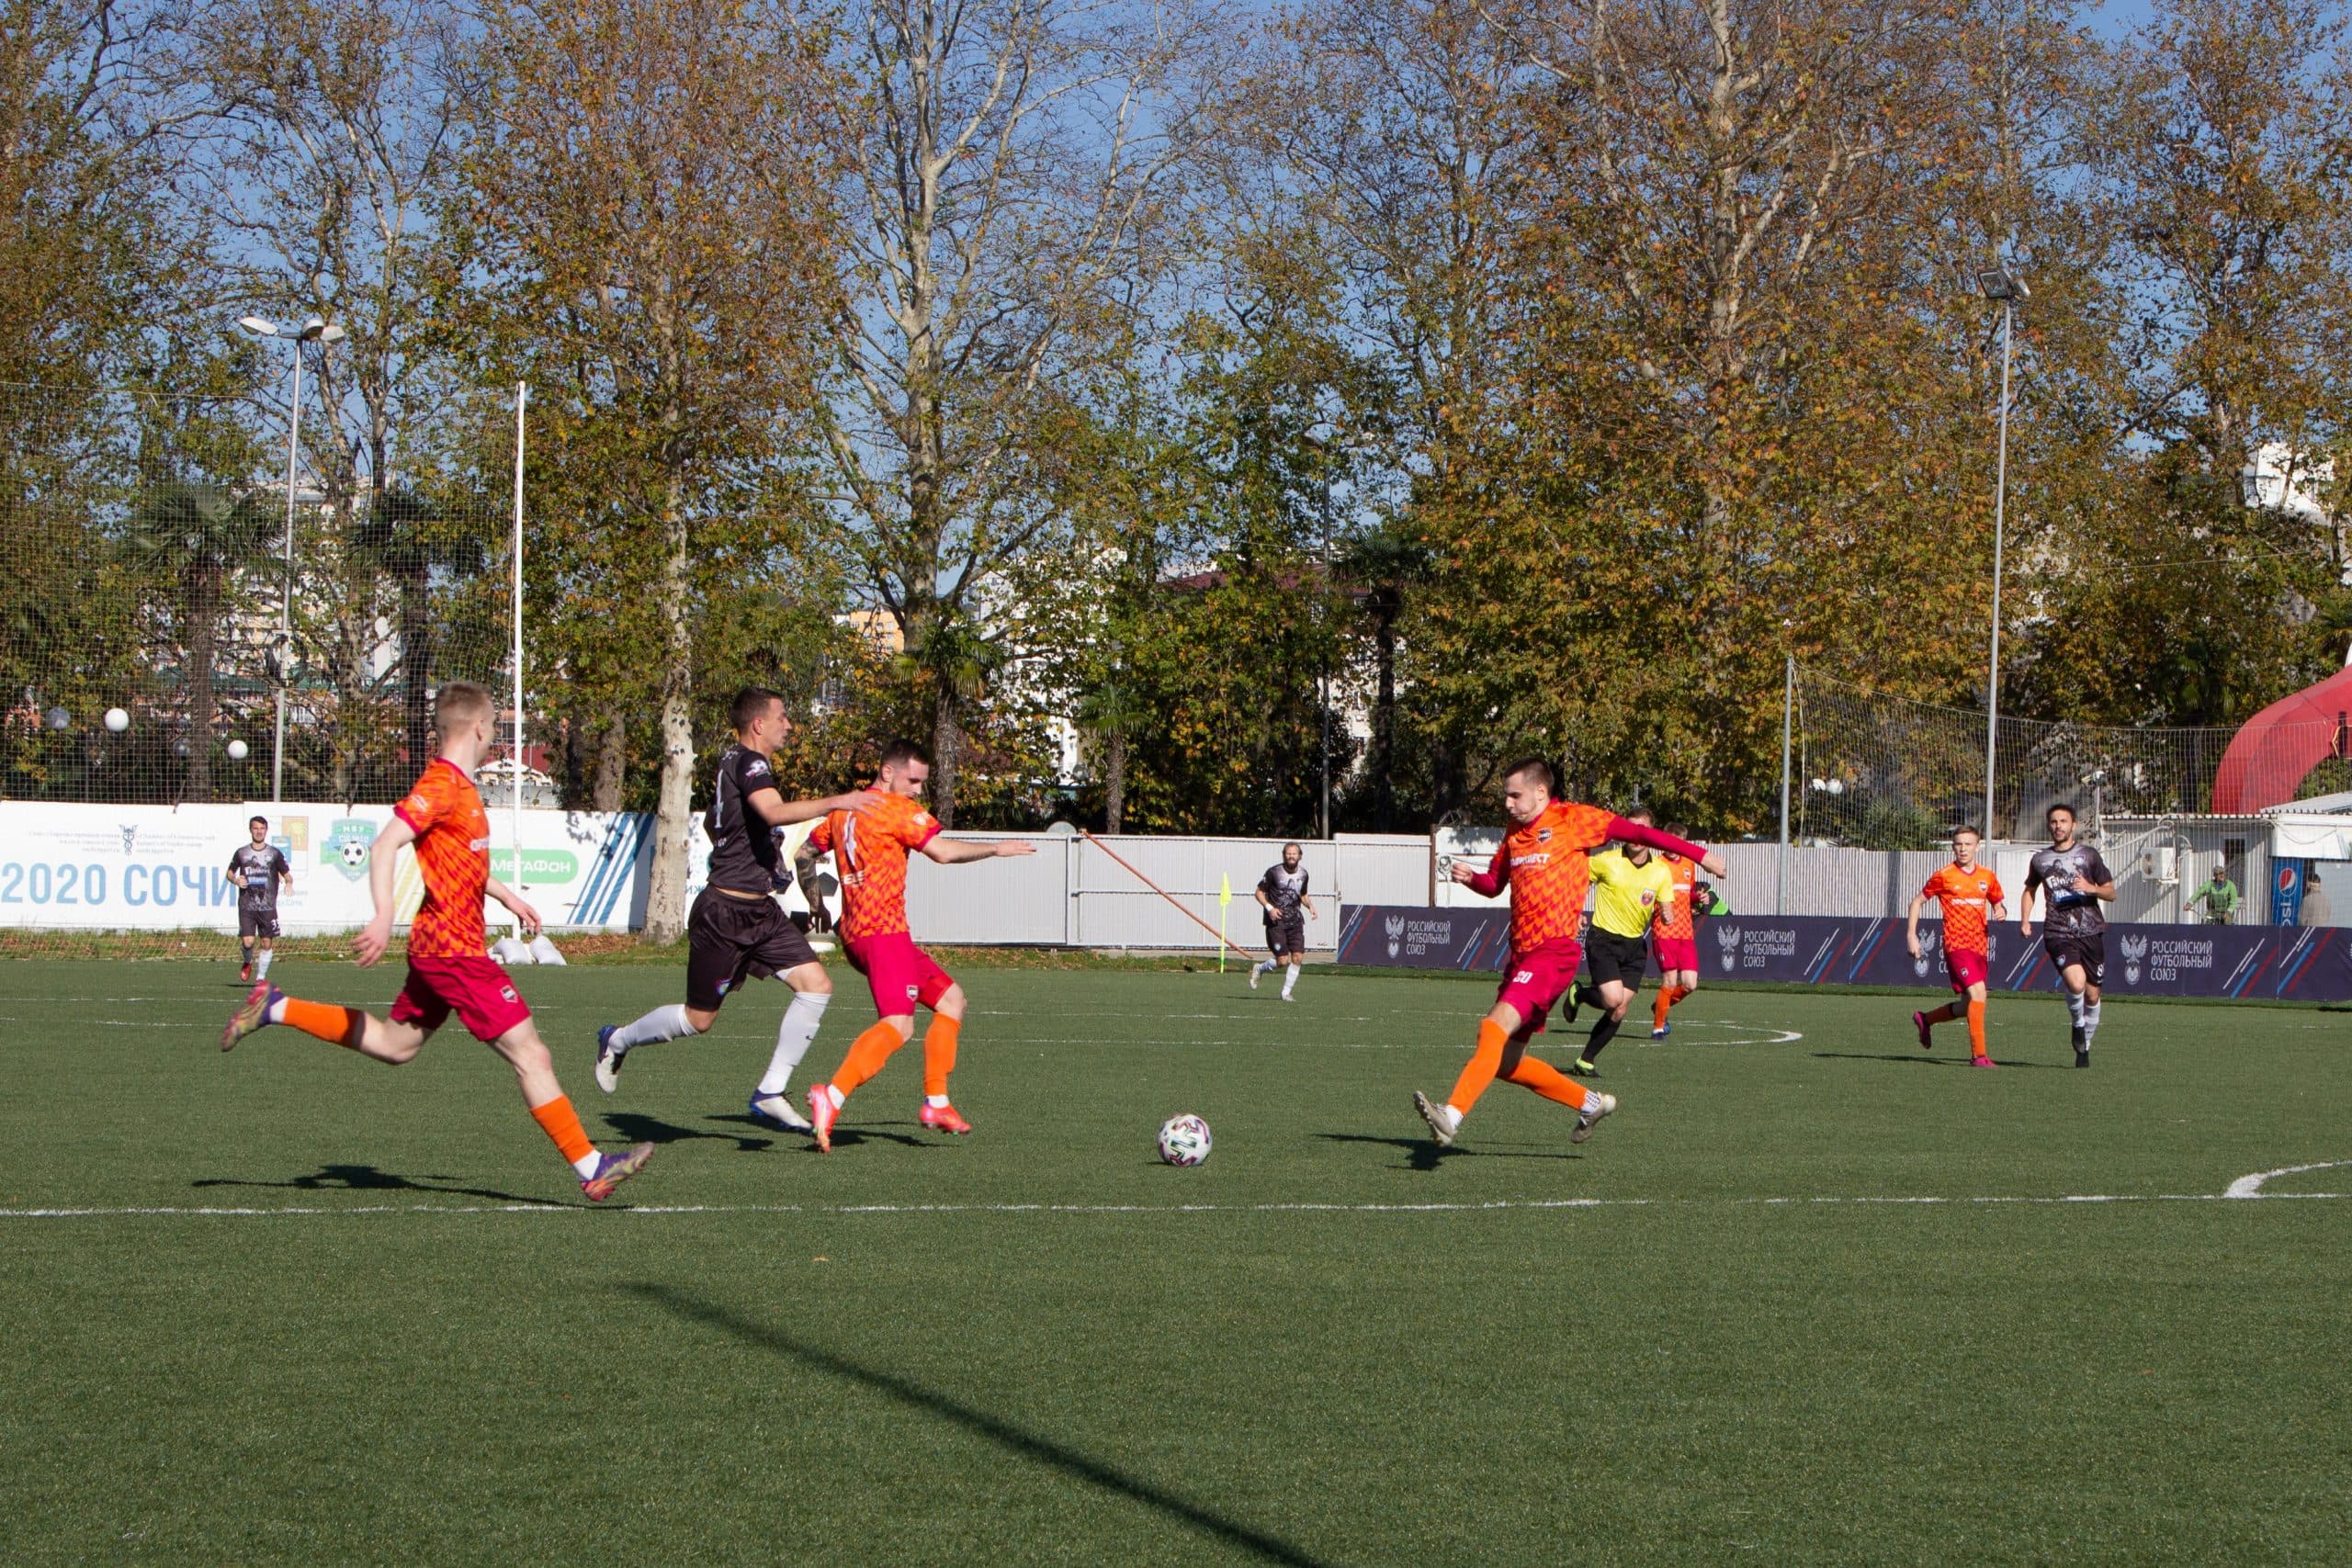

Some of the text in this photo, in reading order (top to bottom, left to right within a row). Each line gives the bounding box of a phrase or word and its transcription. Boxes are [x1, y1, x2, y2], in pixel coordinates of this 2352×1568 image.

[1, 863, 237, 908] 2020 СОЧИ
[1407, 920, 1451, 932] РОССИЙСКИЙ
[1407, 931, 1451, 944] ФУТБОЛЬНЫЙ
[1744, 929, 1795, 942] РОССИЙСКИЙ
[1406, 943, 1426, 955] СОЮЗ
[1743, 942, 1795, 955] ФУТБОЛЬНЫЙ
[2151, 940, 2213, 954] РОССИЙСКИЙ
[1743, 955, 1765, 967] СОЮЗ
[2151, 953, 2212, 968] ФУТБОЛЬНЫЙ
[2150, 968, 2177, 981] СОЮЗ
